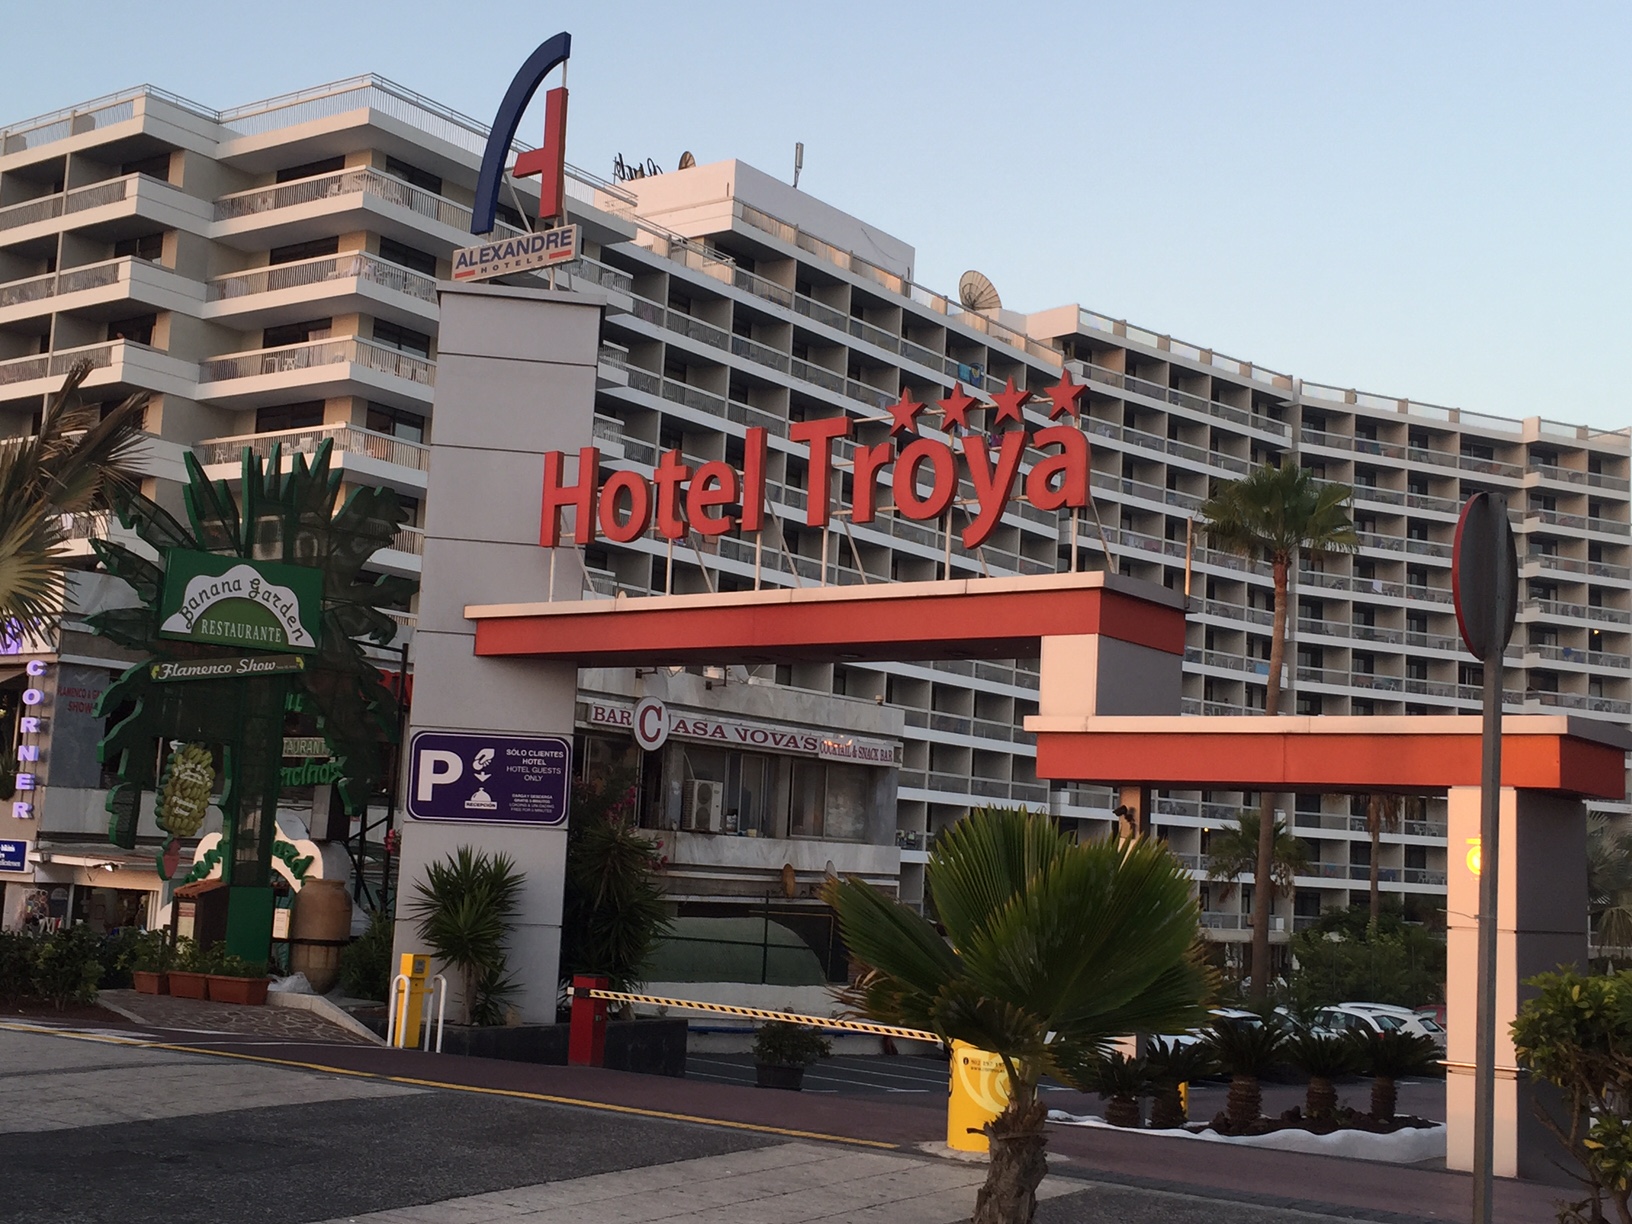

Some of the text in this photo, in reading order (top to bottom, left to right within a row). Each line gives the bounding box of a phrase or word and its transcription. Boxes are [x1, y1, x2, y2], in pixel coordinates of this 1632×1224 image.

[456, 228, 573, 269] ALEXANDRE
[480, 255, 544, 274] HOTELS
[539, 416, 1092, 550] Hotel Troya
[179, 578, 304, 642] Banana Garden
[201, 618, 282, 643] RESTAURANTE
[158, 663, 232, 680] Flamenco
[236, 658, 276, 674] Show
[592, 706, 632, 726] BAR
[12, 659, 47, 819] CORNER
[506, 747, 564, 758] SÓLO CLIENTES
[522, 758, 547, 766] HOTEL
[858, 746, 879, 761] SNACK
[880, 748, 893, 762] BAR
[417, 749, 464, 802] P
[523, 774, 544, 782] ONLY
[531, 767, 562, 775] GUESTS
